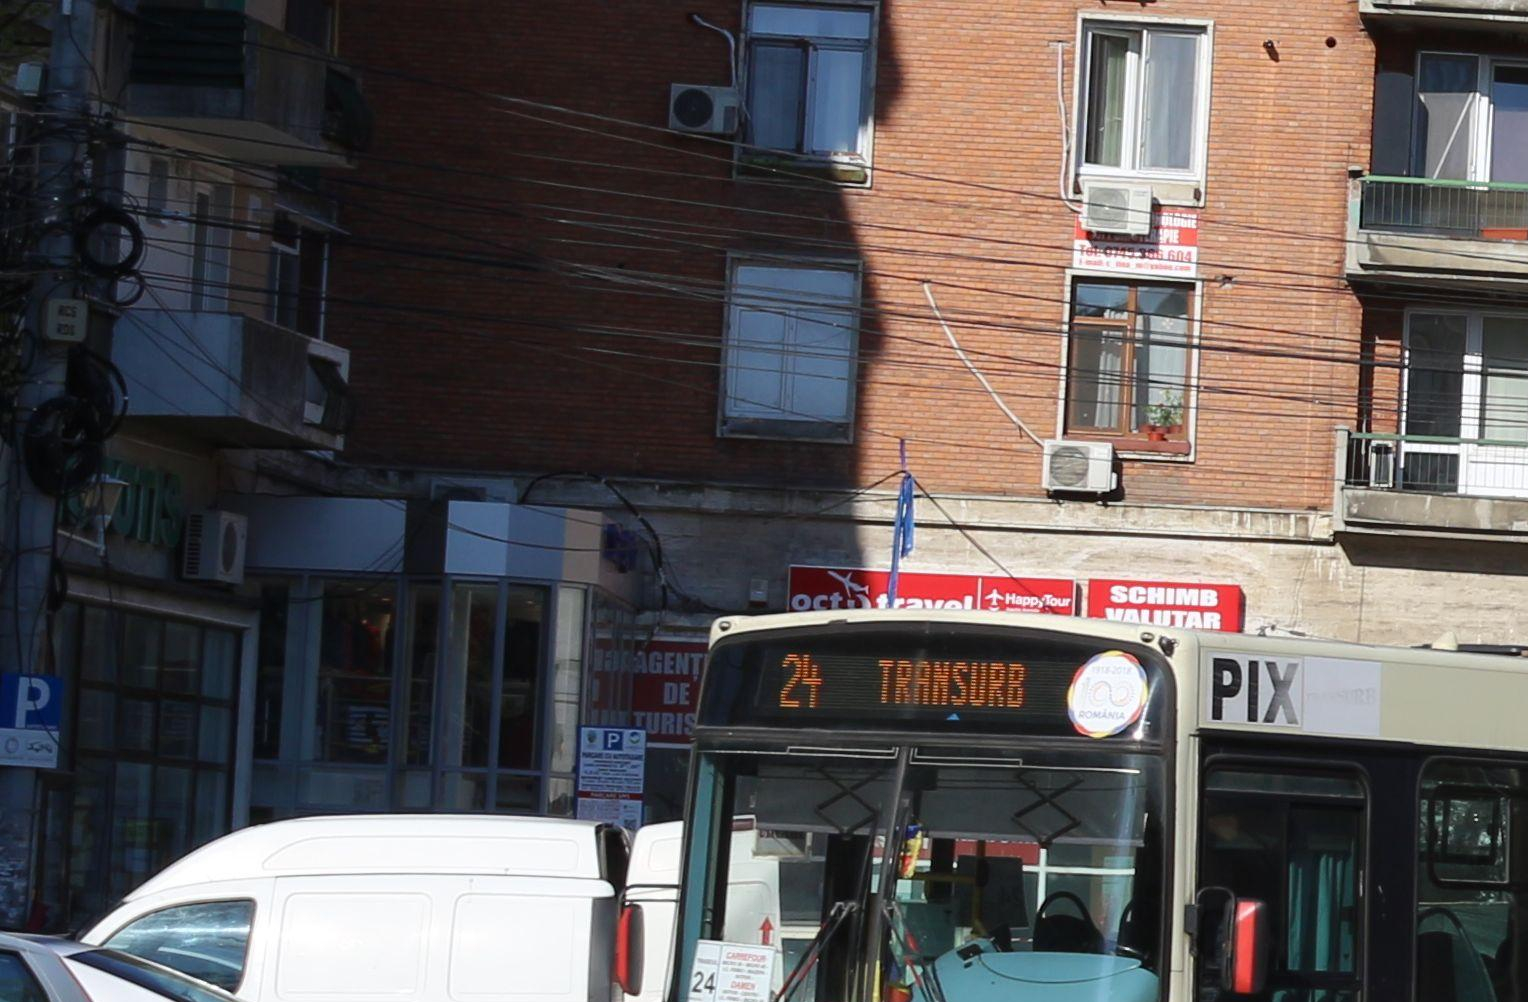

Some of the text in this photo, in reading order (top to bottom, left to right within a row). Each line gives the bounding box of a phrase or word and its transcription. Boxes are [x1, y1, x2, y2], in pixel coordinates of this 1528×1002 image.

[1110, 585, 1219, 607] SCHIMB
[1105, 607, 1222, 630] VALUTAR
[779, 653, 1026, 708] 24 TRANSURB
[1212, 657, 1299, 725] PIX
[15, 676, 51, 729] P
[664, 682, 690, 705] DE
[1078, 708, 1126, 720] ROMÂNIA
[607, 732, 620, 749] P
[692, 971, 716, 994] 24
